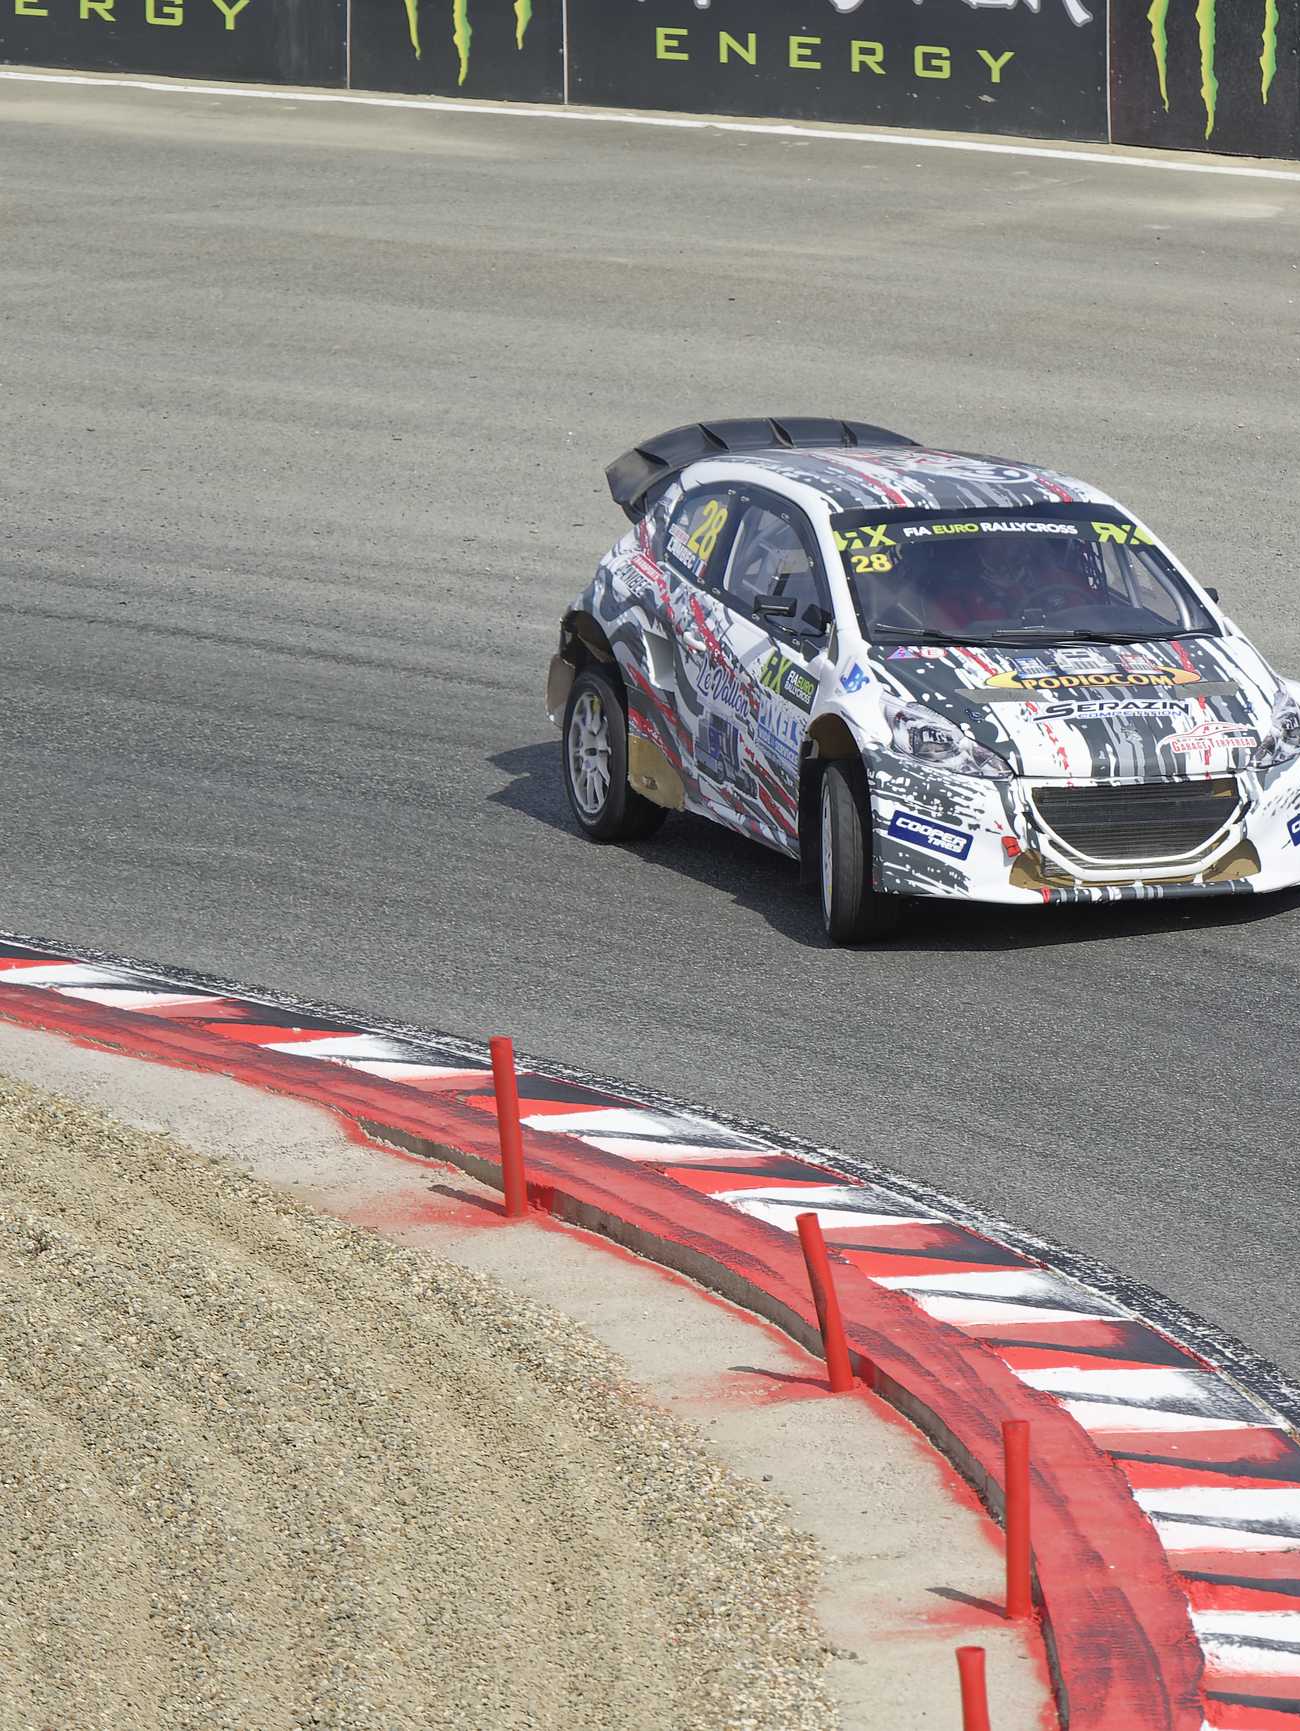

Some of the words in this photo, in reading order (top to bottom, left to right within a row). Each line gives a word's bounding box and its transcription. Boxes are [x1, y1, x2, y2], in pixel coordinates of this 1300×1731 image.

[655, 27, 1015, 83] ENERGY
[686, 499, 729, 562] 28
[902, 526, 931, 538] FIA
[932, 523, 979, 535] EURO
[979, 521, 1079, 535] RALLYCROSS
[850, 553, 893, 574] 28
[1021, 673, 1175, 690] PODIOCOM
[1032, 701, 1190, 721] SERAZIN
[895, 817, 967, 845] COOPER
[927, 836, 963, 853] TIRES
